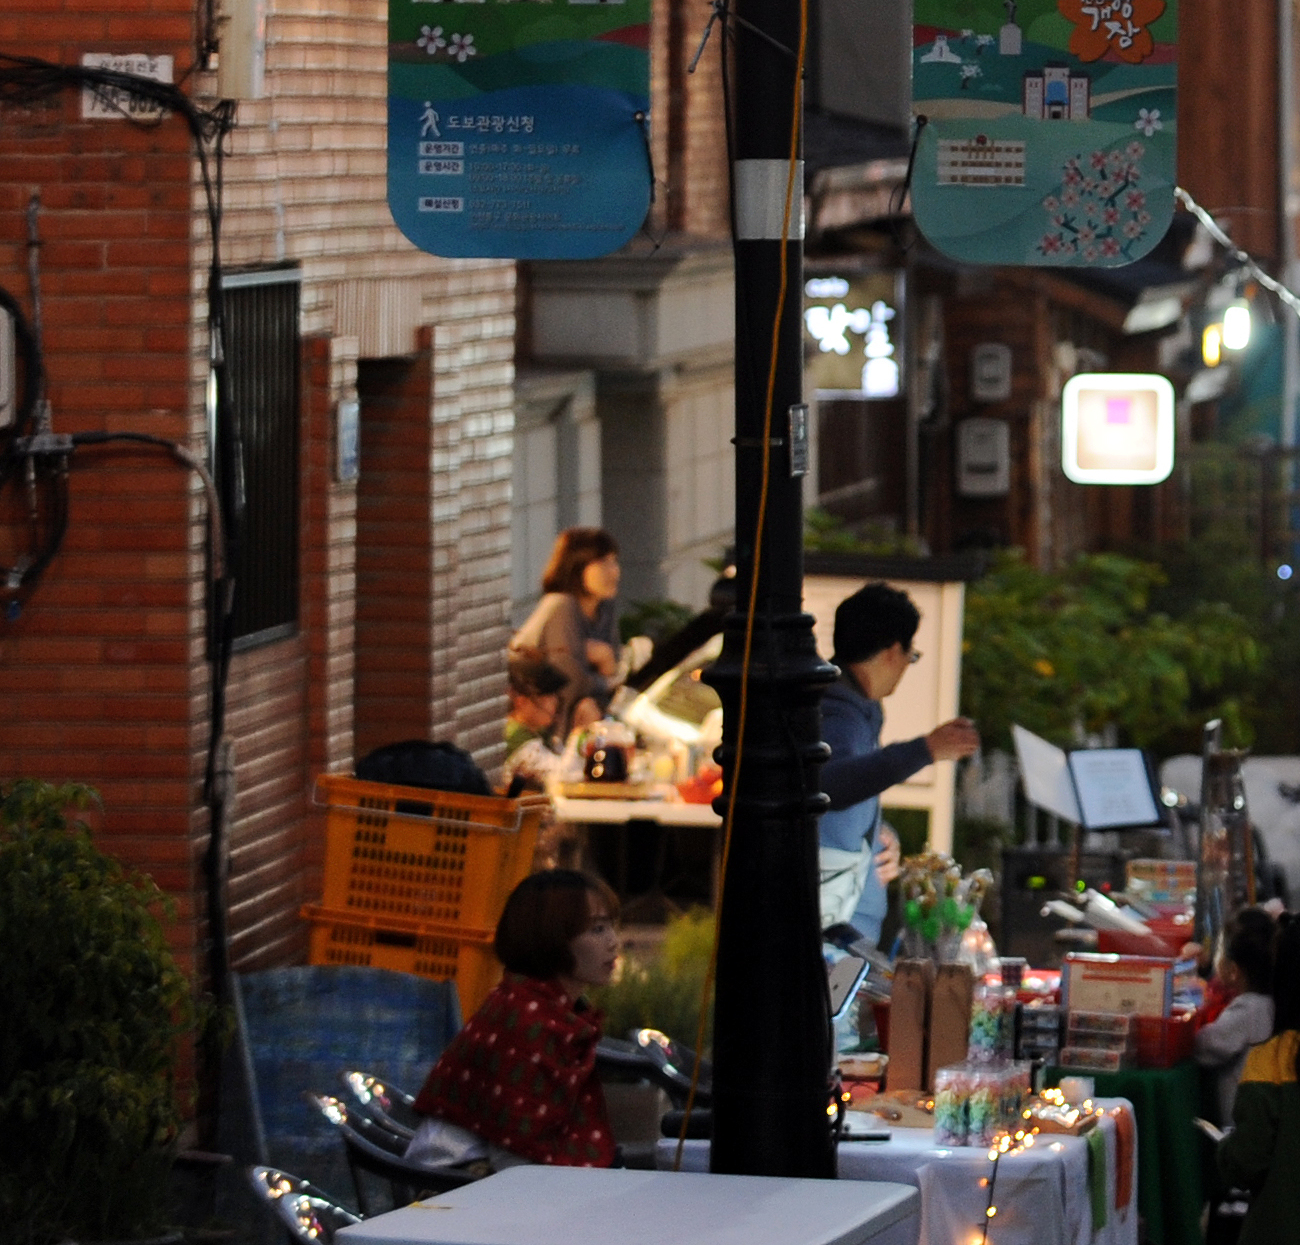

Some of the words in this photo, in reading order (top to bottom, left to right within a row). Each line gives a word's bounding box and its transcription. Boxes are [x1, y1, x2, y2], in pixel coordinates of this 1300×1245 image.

[446, 115, 535, 133] 도보관광신청
[424, 143, 460, 154] 운영기간
[424, 161, 460, 172] 운영시간
